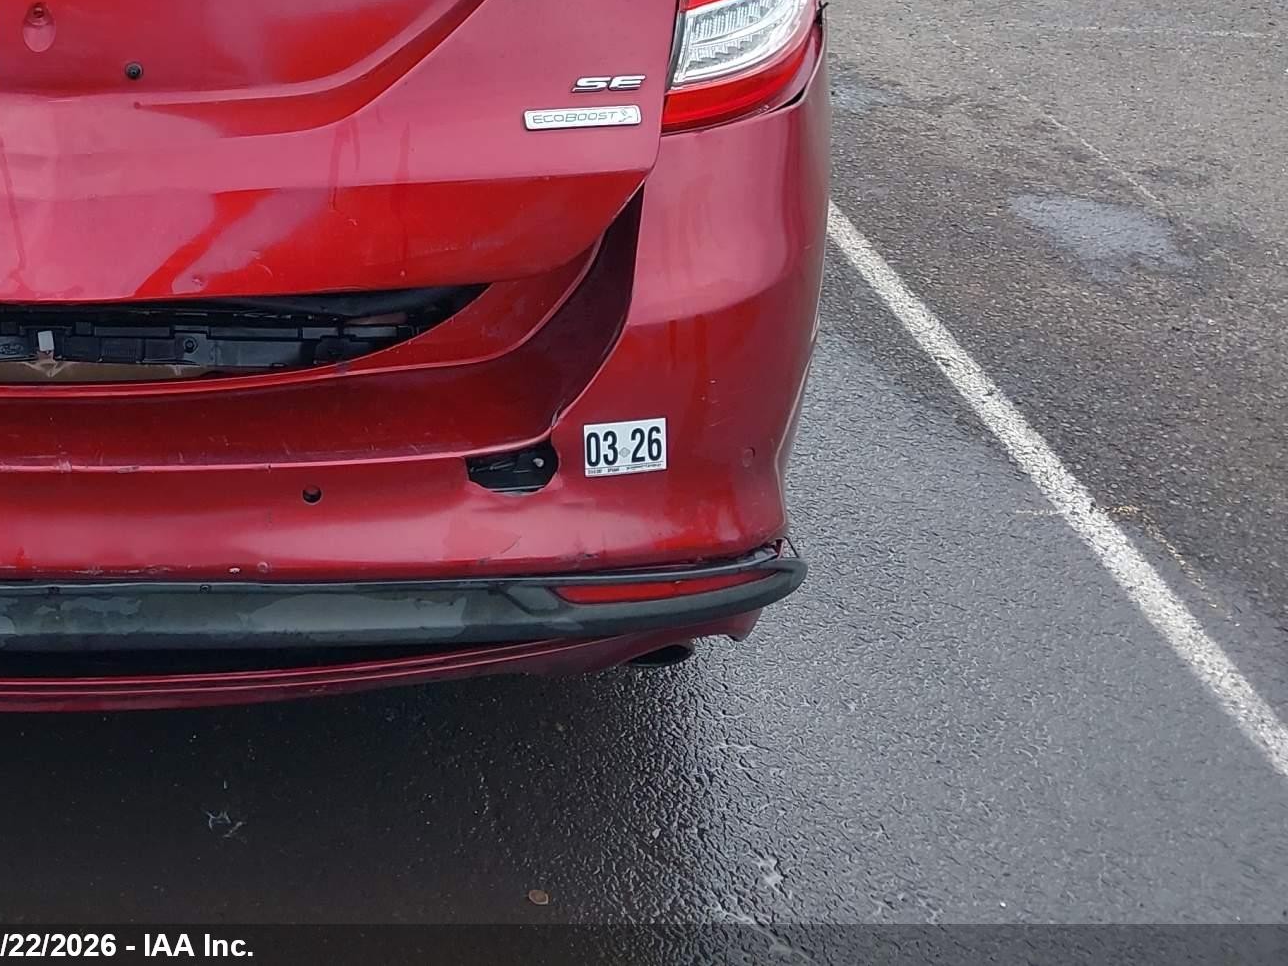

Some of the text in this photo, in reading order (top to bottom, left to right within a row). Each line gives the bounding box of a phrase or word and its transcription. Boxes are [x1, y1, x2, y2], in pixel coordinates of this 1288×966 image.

[571, 75, 646, 93] SE
[586, 425, 663, 467] 03 26
